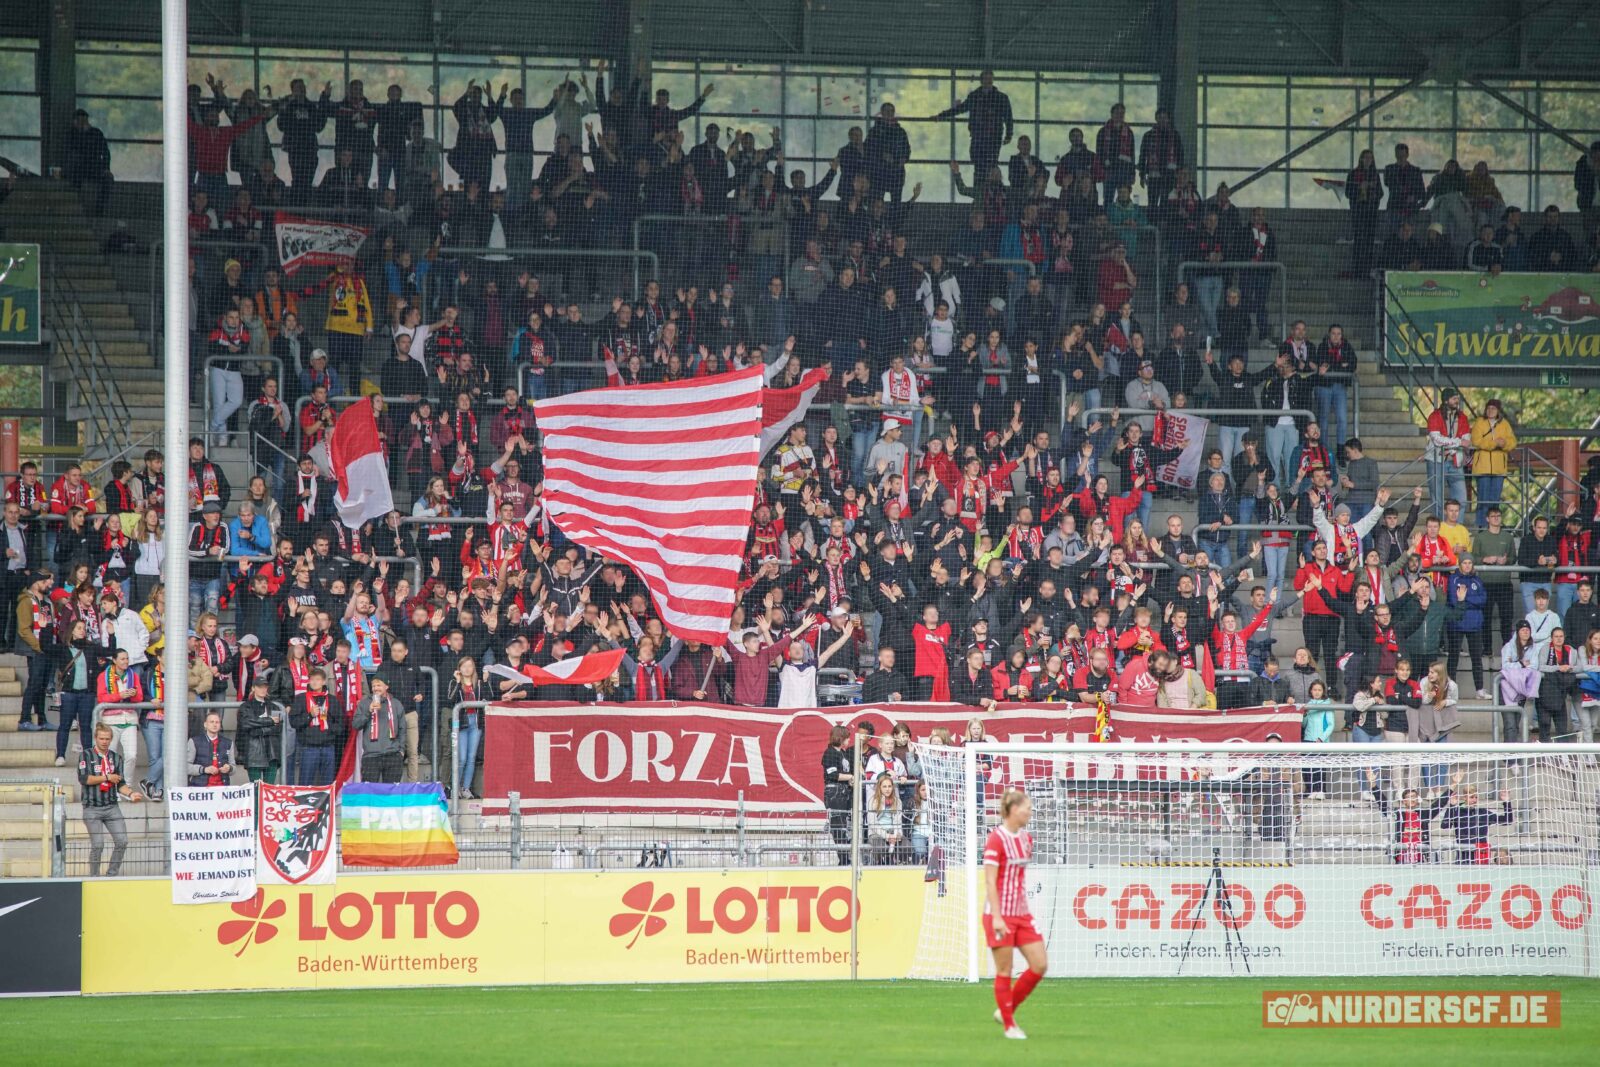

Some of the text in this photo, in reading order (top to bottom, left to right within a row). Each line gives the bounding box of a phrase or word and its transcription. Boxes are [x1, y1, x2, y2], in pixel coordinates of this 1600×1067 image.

[533, 728, 768, 788] FORZA
[171, 789, 251, 801] ES GEHT NICHT
[172, 808, 252, 822] DARUM, WOHER
[361, 807, 440, 831] PACE
[174, 832, 213, 841] JEMAND
[215, 829, 253, 840] KOMMT,
[175, 852, 187, 861] ES
[189, 851, 214, 861] GEHT
[176, 872, 194, 881] WIE
[197, 871, 236, 880] JEMAND
[686, 885, 861, 934] LOTTO
[1073, 884, 1307, 929] CAZOO
[1360, 883, 1593, 930] CAZOO
[299, 891, 480, 941] LOTTO
[1095, 944, 1156, 958] Finden.
[1161, 944, 1221, 958] Fahren.
[1382, 943, 1442, 958] Finden.
[298, 954, 479, 974] Baden-Württemberg
